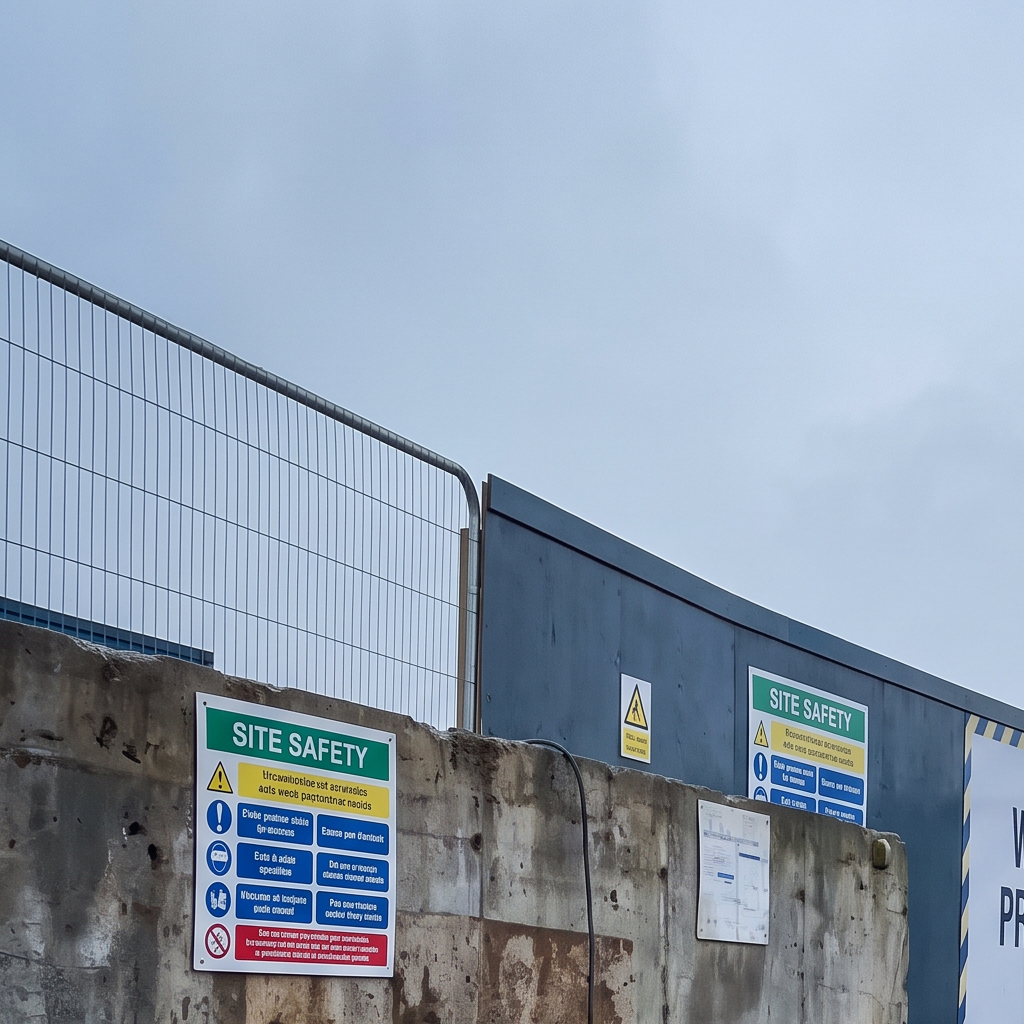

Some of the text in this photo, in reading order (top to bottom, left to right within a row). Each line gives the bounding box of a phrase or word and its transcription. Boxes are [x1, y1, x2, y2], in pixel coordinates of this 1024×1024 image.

[770, 687, 852, 732] SITE SAFETY
[232, 721, 368, 769] SITE SAFETY
